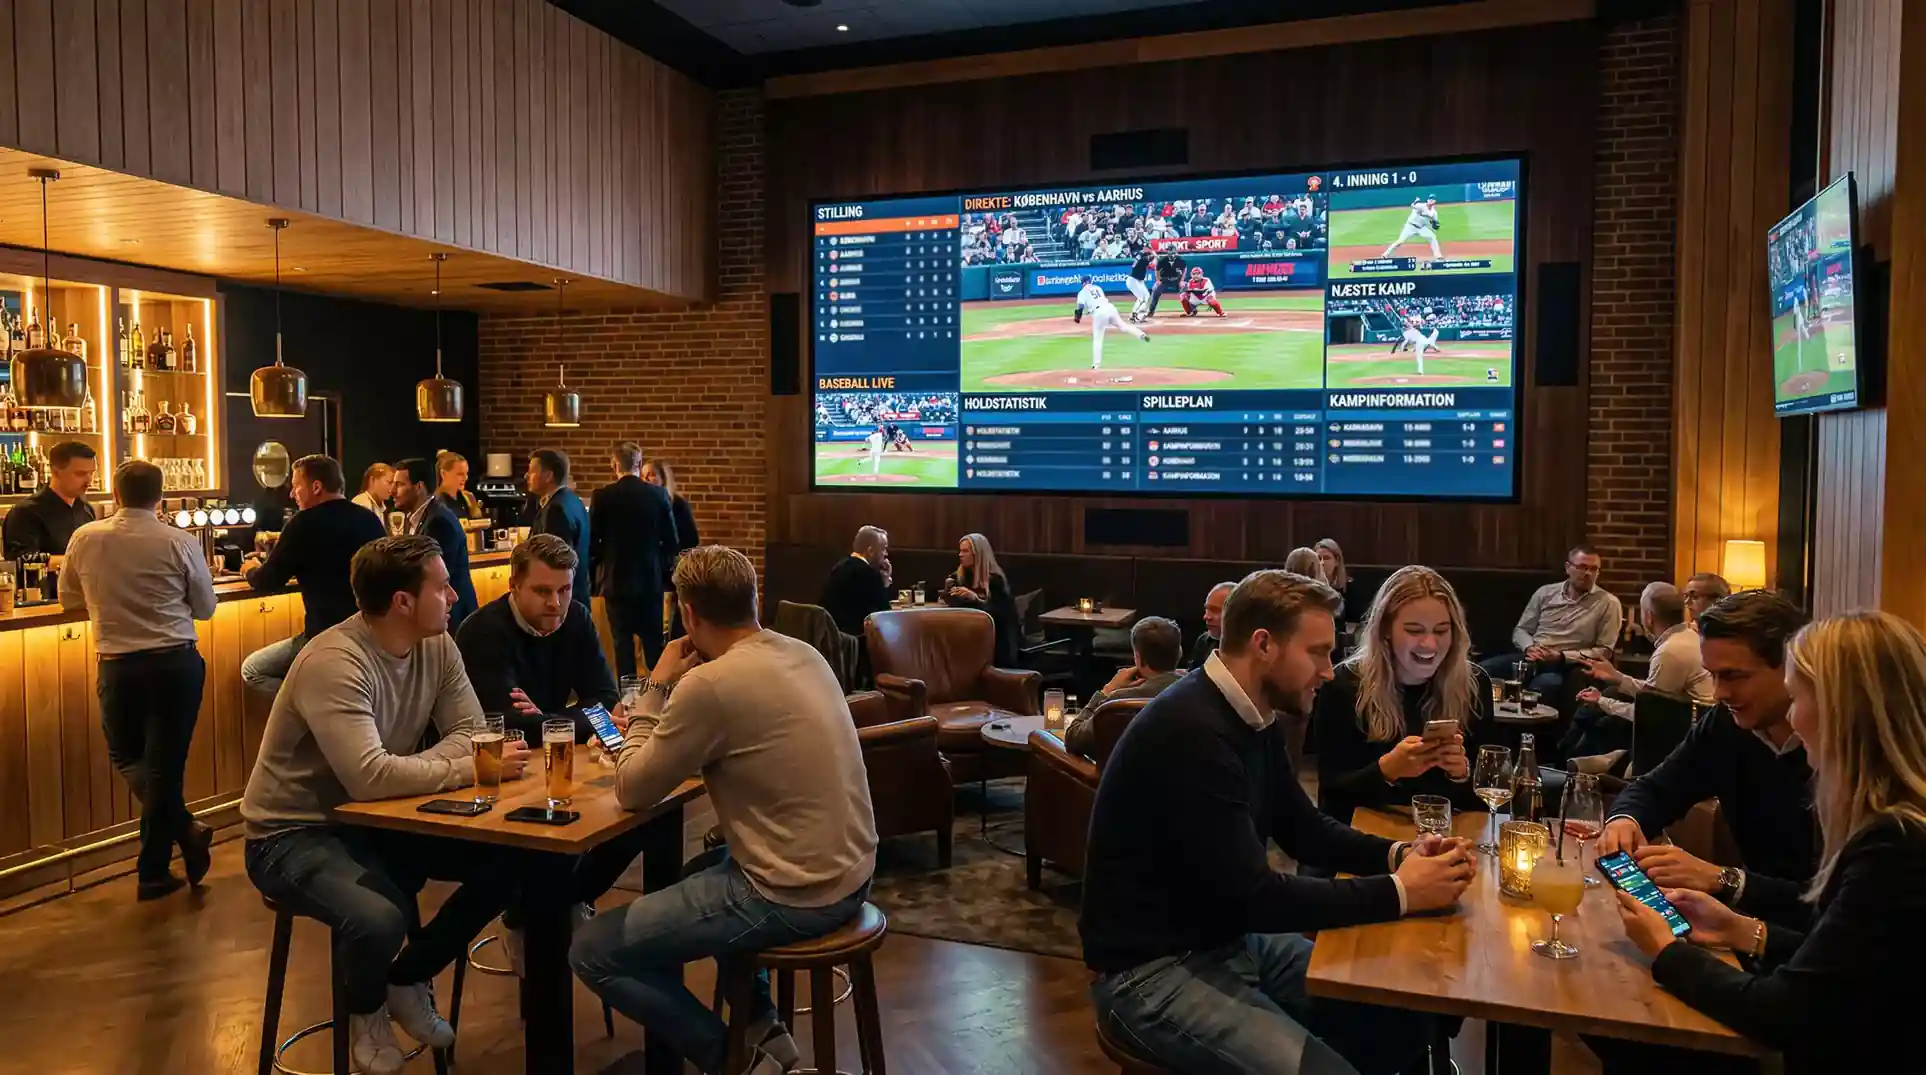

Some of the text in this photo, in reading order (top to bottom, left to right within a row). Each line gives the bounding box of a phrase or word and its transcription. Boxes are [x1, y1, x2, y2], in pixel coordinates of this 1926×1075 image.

[1332, 175, 1344, 188] 4.
[1347, 173, 1388, 187] INNING
[1392, 172, 1398, 184] 1
[1409, 171, 1417, 183] 0
[964, 187, 1143, 210] DIREKTE: KØBENHAVN vs AARHUS
[818, 206, 863, 219] STILLING
[1195, 239, 1228, 250] SPORT
[1331, 282, 1416, 297] NÆSTE KAMP
[819, 377, 895, 389] BASEBALL LIVE
[964, 397, 1047, 409] HOLDSTATISTIK
[1143, 396, 1213, 408] SPILLEPLAN
[1330, 393, 1455, 407] KAMPINFORMATION
